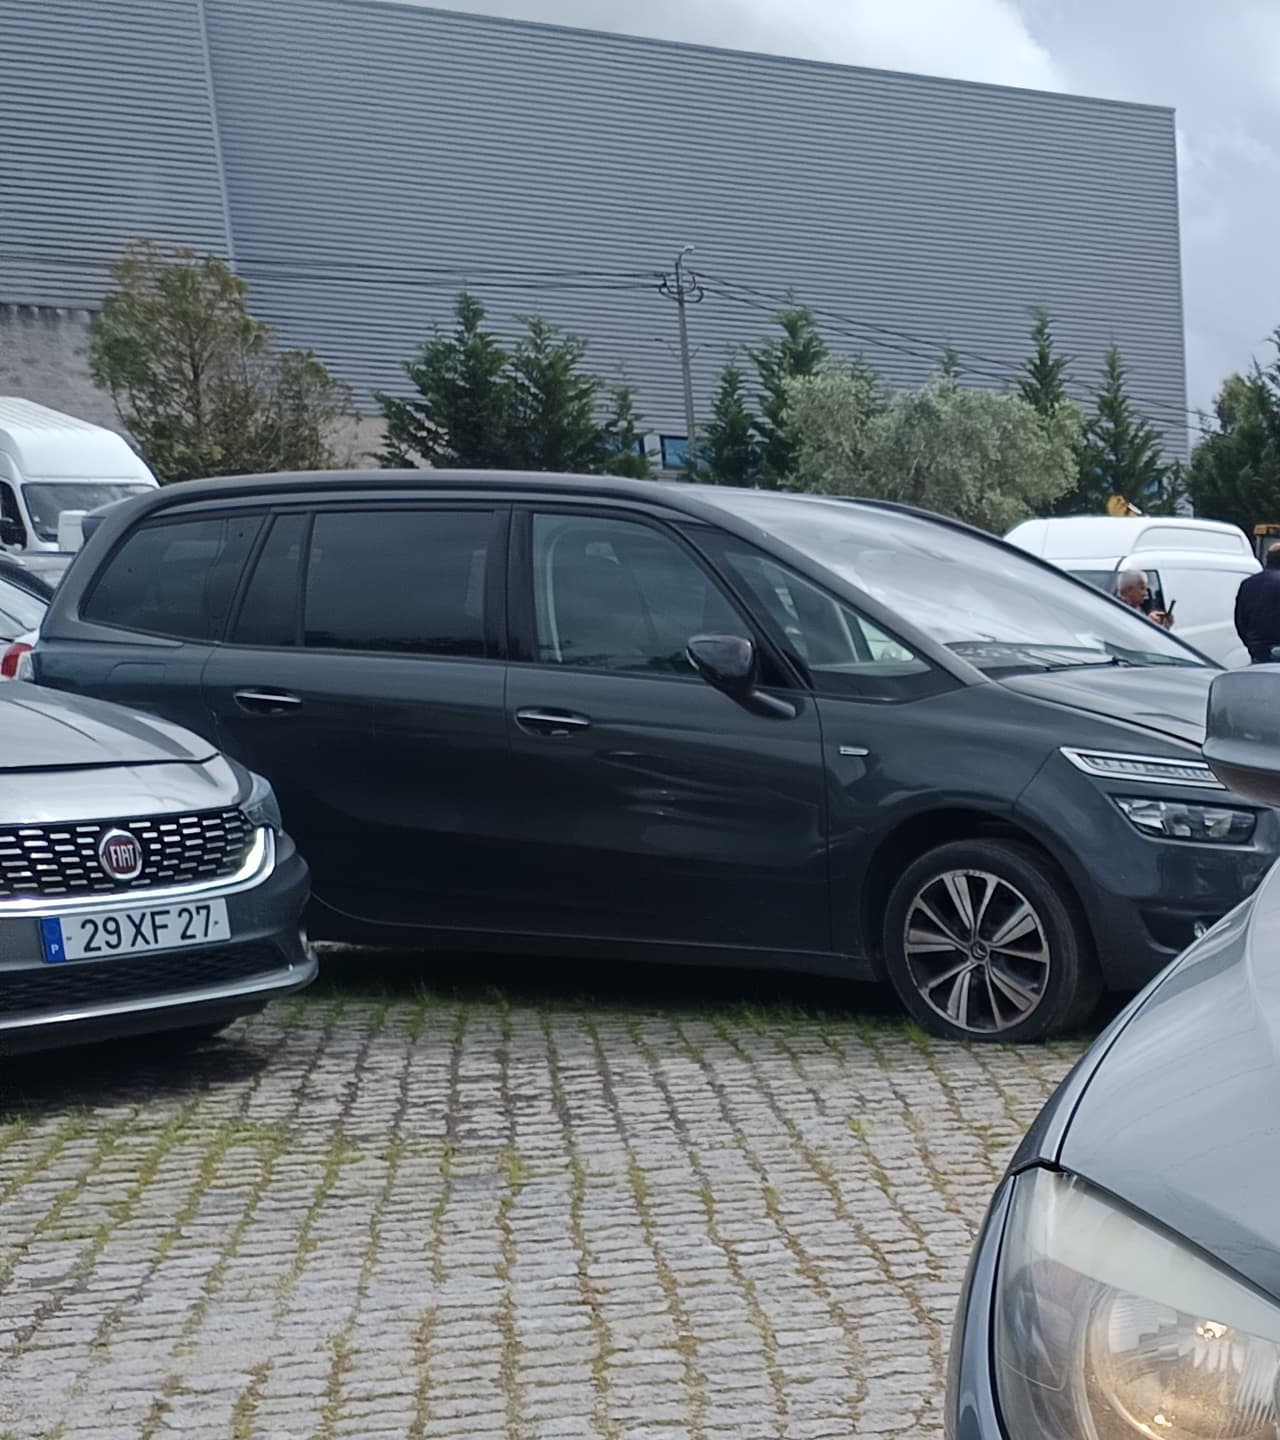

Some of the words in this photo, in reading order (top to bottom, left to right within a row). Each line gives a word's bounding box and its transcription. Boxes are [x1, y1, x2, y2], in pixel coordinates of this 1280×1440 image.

[109, 844, 135, 869] FIAT
[80, 916, 122, 952] 29
[126, 910, 171, 947] XF
[177, 905, 211, 941] 27
[50, 943, 60, 955] P
